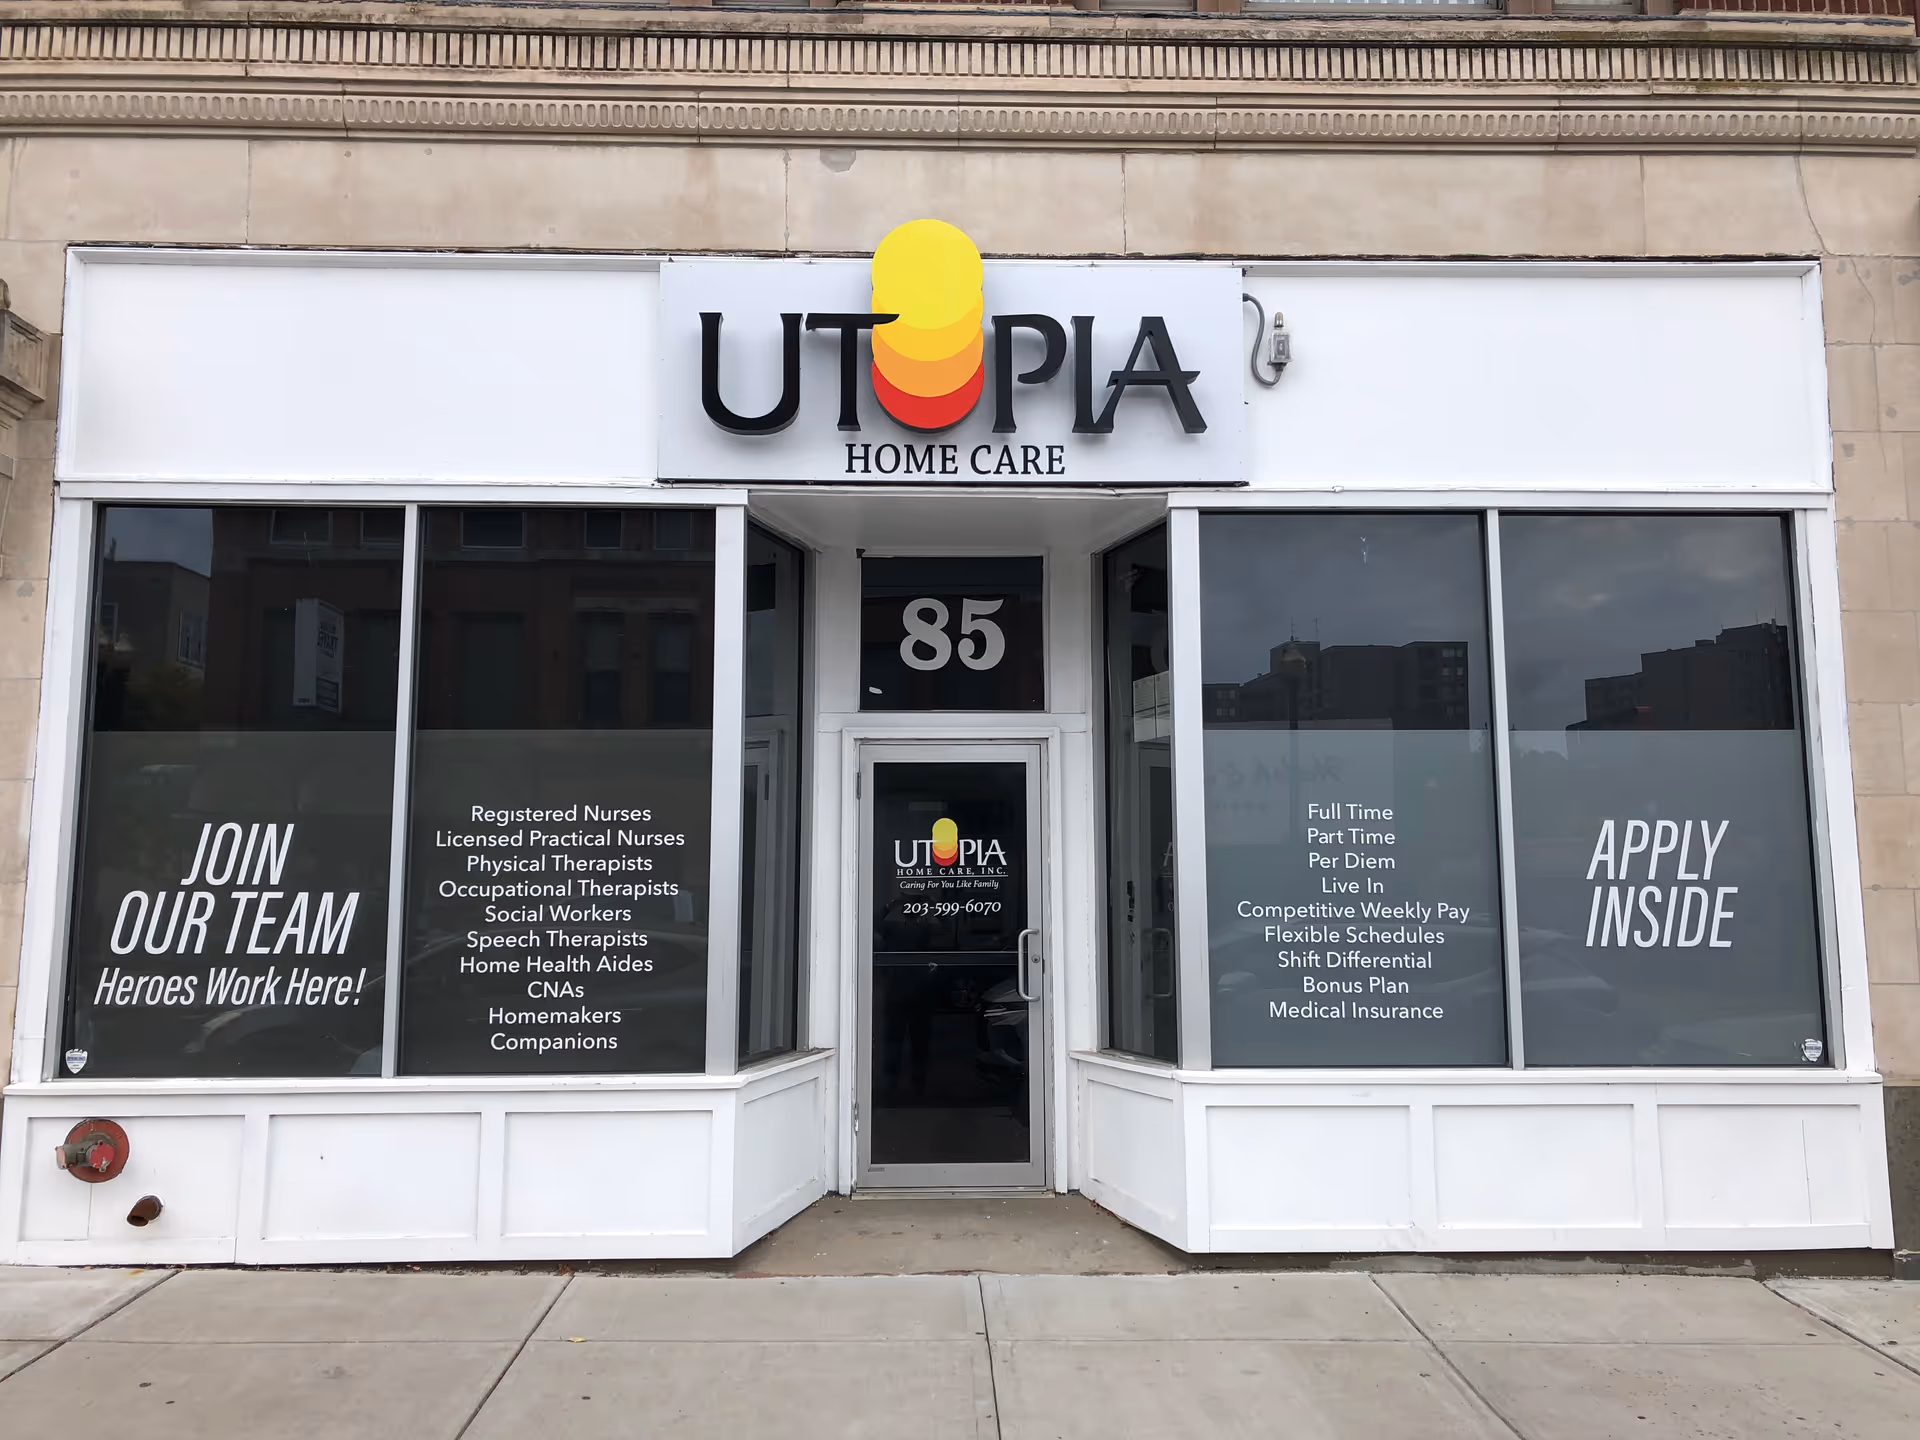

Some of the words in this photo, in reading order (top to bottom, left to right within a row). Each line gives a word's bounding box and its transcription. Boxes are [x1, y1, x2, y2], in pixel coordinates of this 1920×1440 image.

[698, 218, 1208, 436] UTOPIA
[845, 443, 958, 474] HOME
[971, 445, 1065, 474] CARE
[900, 598, 1005, 670] 85
[472, 805, 576, 826] Registered
[585, 805, 651, 821] Nurses
[1309, 803, 1340, 819] Full
[1346, 804, 1393, 820] Time
[437, 830, 522, 846] Licensed
[530, 829, 610, 846] Practical
[618, 830, 684, 845] Nurses
[894, 817, 1008, 868] UTOPIA
[1308, 828, 1343, 844] Part
[1348, 828, 1395, 844] Time
[181, 823, 294, 885] JOIN
[1586, 820, 1729, 880] APPLY
[468, 854, 545, 876] Physical
[551, 854, 652, 875] Therapists
[1310, 853, 1339, 868] Per
[1345, 853, 1395, 868] Diem
[896, 868, 933, 876] HOME
[939, 868, 975, 876] CARE,
[981, 867, 1006, 875] INC.
[439, 879, 571, 901] Occupational
[577, 879, 678, 900] Therapists
[899, 880, 926, 890] Caring
[927, 880, 939, 889] For
[941, 880, 954, 888] You
[956, 880, 972, 888] Like
[973, 880, 999, 890] Family
[1323, 877, 1359, 893] Live
[1368, 878, 1383, 893] In
[485, 905, 543, 922] Social
[550, 904, 631, 921] Workers
[903, 898, 1002, 916] 203-599-6070
[1238, 901, 1355, 922] Competitive
[1361, 902, 1431, 923] Weekly
[1438, 903, 1469, 923] Pay
[1586, 886, 1738, 947] INSIDE
[111, 891, 215, 954] OUR
[225, 892, 360, 954] TEAM
[467, 930, 539, 952] Speech
[546, 930, 647, 951] Therapists
[1265, 925, 1339, 942] Flexible
[1347, 926, 1444, 943] Schedules
[461, 957, 519, 973] Home
[527, 955, 590, 972] Health
[596, 954, 653, 971] Aides
[1279, 951, 1320, 967] Shift
[1327, 951, 1431, 968] Differential
[94, 968, 197, 1005] Heroes
[205, 966, 282, 1005] Work
[284, 968, 366, 1005] Here!
[528, 981, 584, 998] CNAs
[1304, 977, 1362, 993] Bonus
[1370, 977, 1408, 993] Plan
[490, 1006, 621, 1024] Homemakers
[1270, 1001, 1345, 1018] Medical
[1353, 1002, 1443, 1018] Insurance
[491, 1033, 617, 1054] Companions
